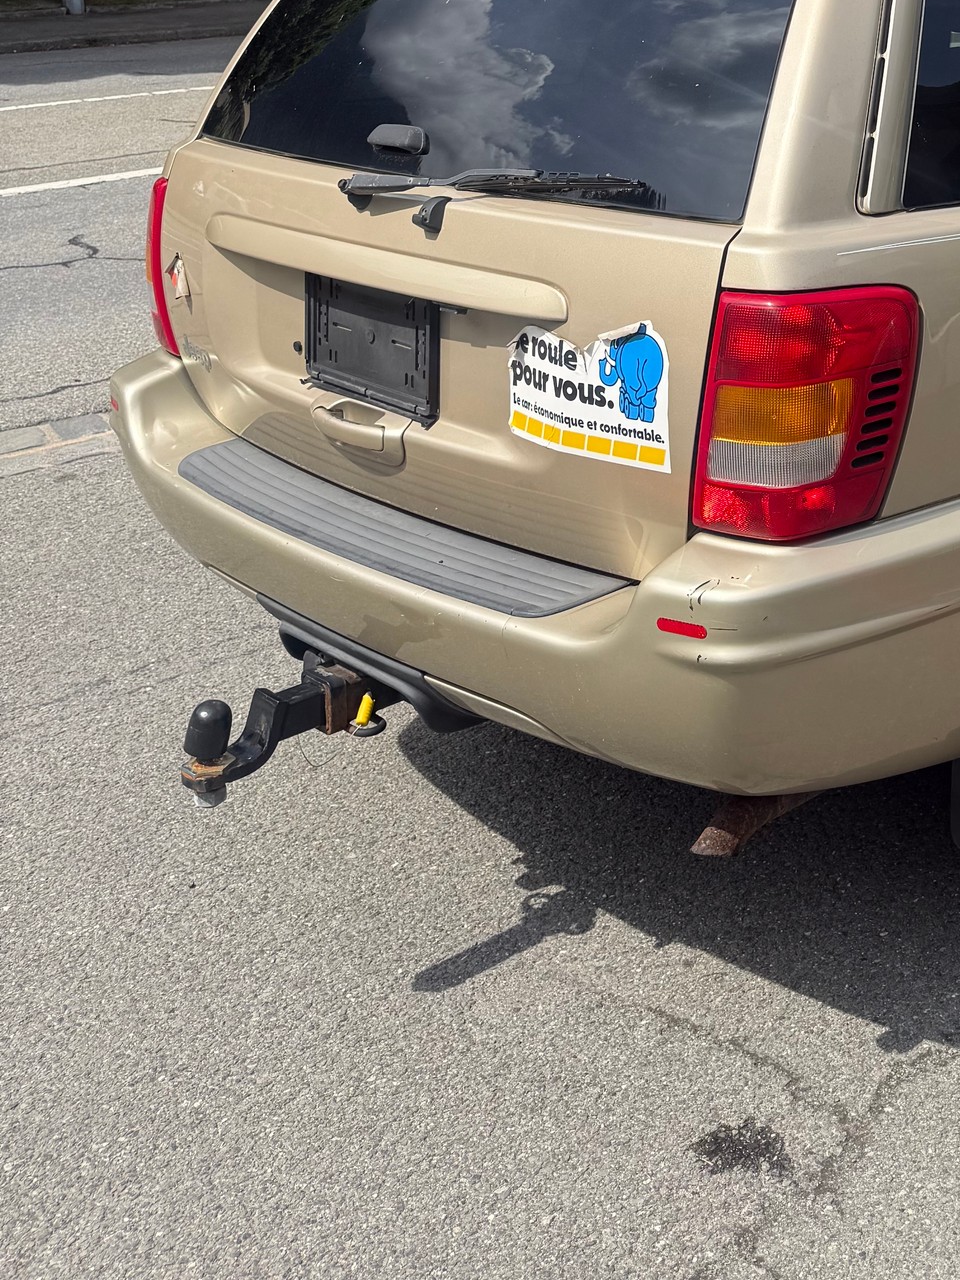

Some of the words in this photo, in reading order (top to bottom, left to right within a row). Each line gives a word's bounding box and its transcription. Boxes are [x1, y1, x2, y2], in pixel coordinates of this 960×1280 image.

[532, 336, 577, 371] roule
[511, 360, 549, 393] pour
[553, 376, 614, 409] vous.
[513, 392, 521, 407] Le
[534, 401, 584, 429] économique
[587, 420, 597, 431] et
[600, 423, 665, 444] confortable.
